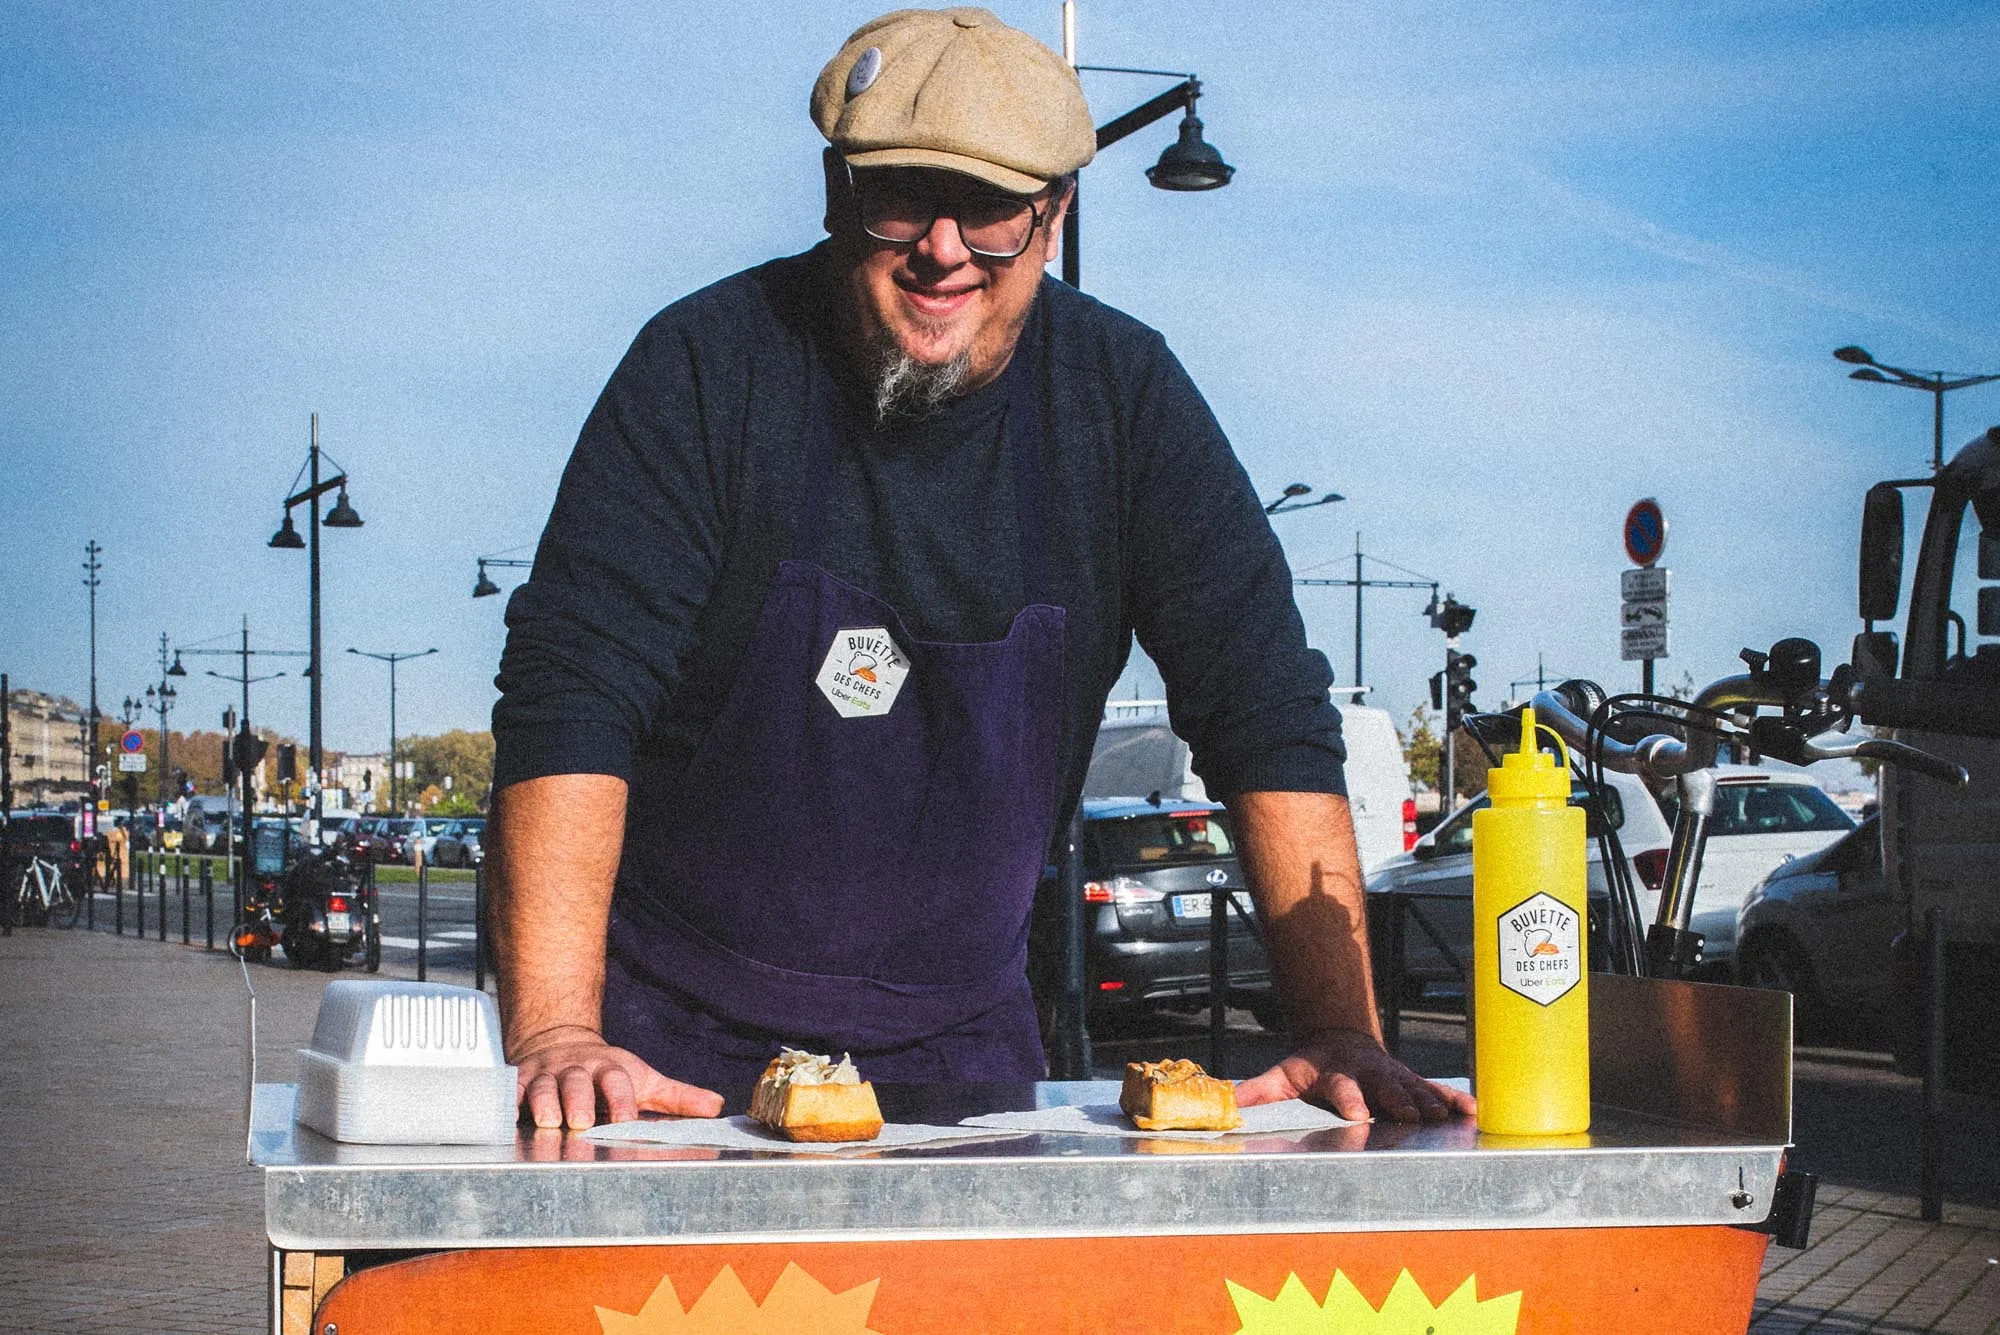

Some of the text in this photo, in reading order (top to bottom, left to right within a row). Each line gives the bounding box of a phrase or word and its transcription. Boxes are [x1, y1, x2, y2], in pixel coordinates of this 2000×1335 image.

[848, 636, 900, 668] BUVETTE
[834, 672, 882, 700] DES CHEFS
[831, 687, 871, 711] Uber Eats
[1510, 909, 1571, 932] BUVETTE
[1516, 959, 1569, 972] DES CHEFS
[1520, 977, 1566, 987] Uber Eats
